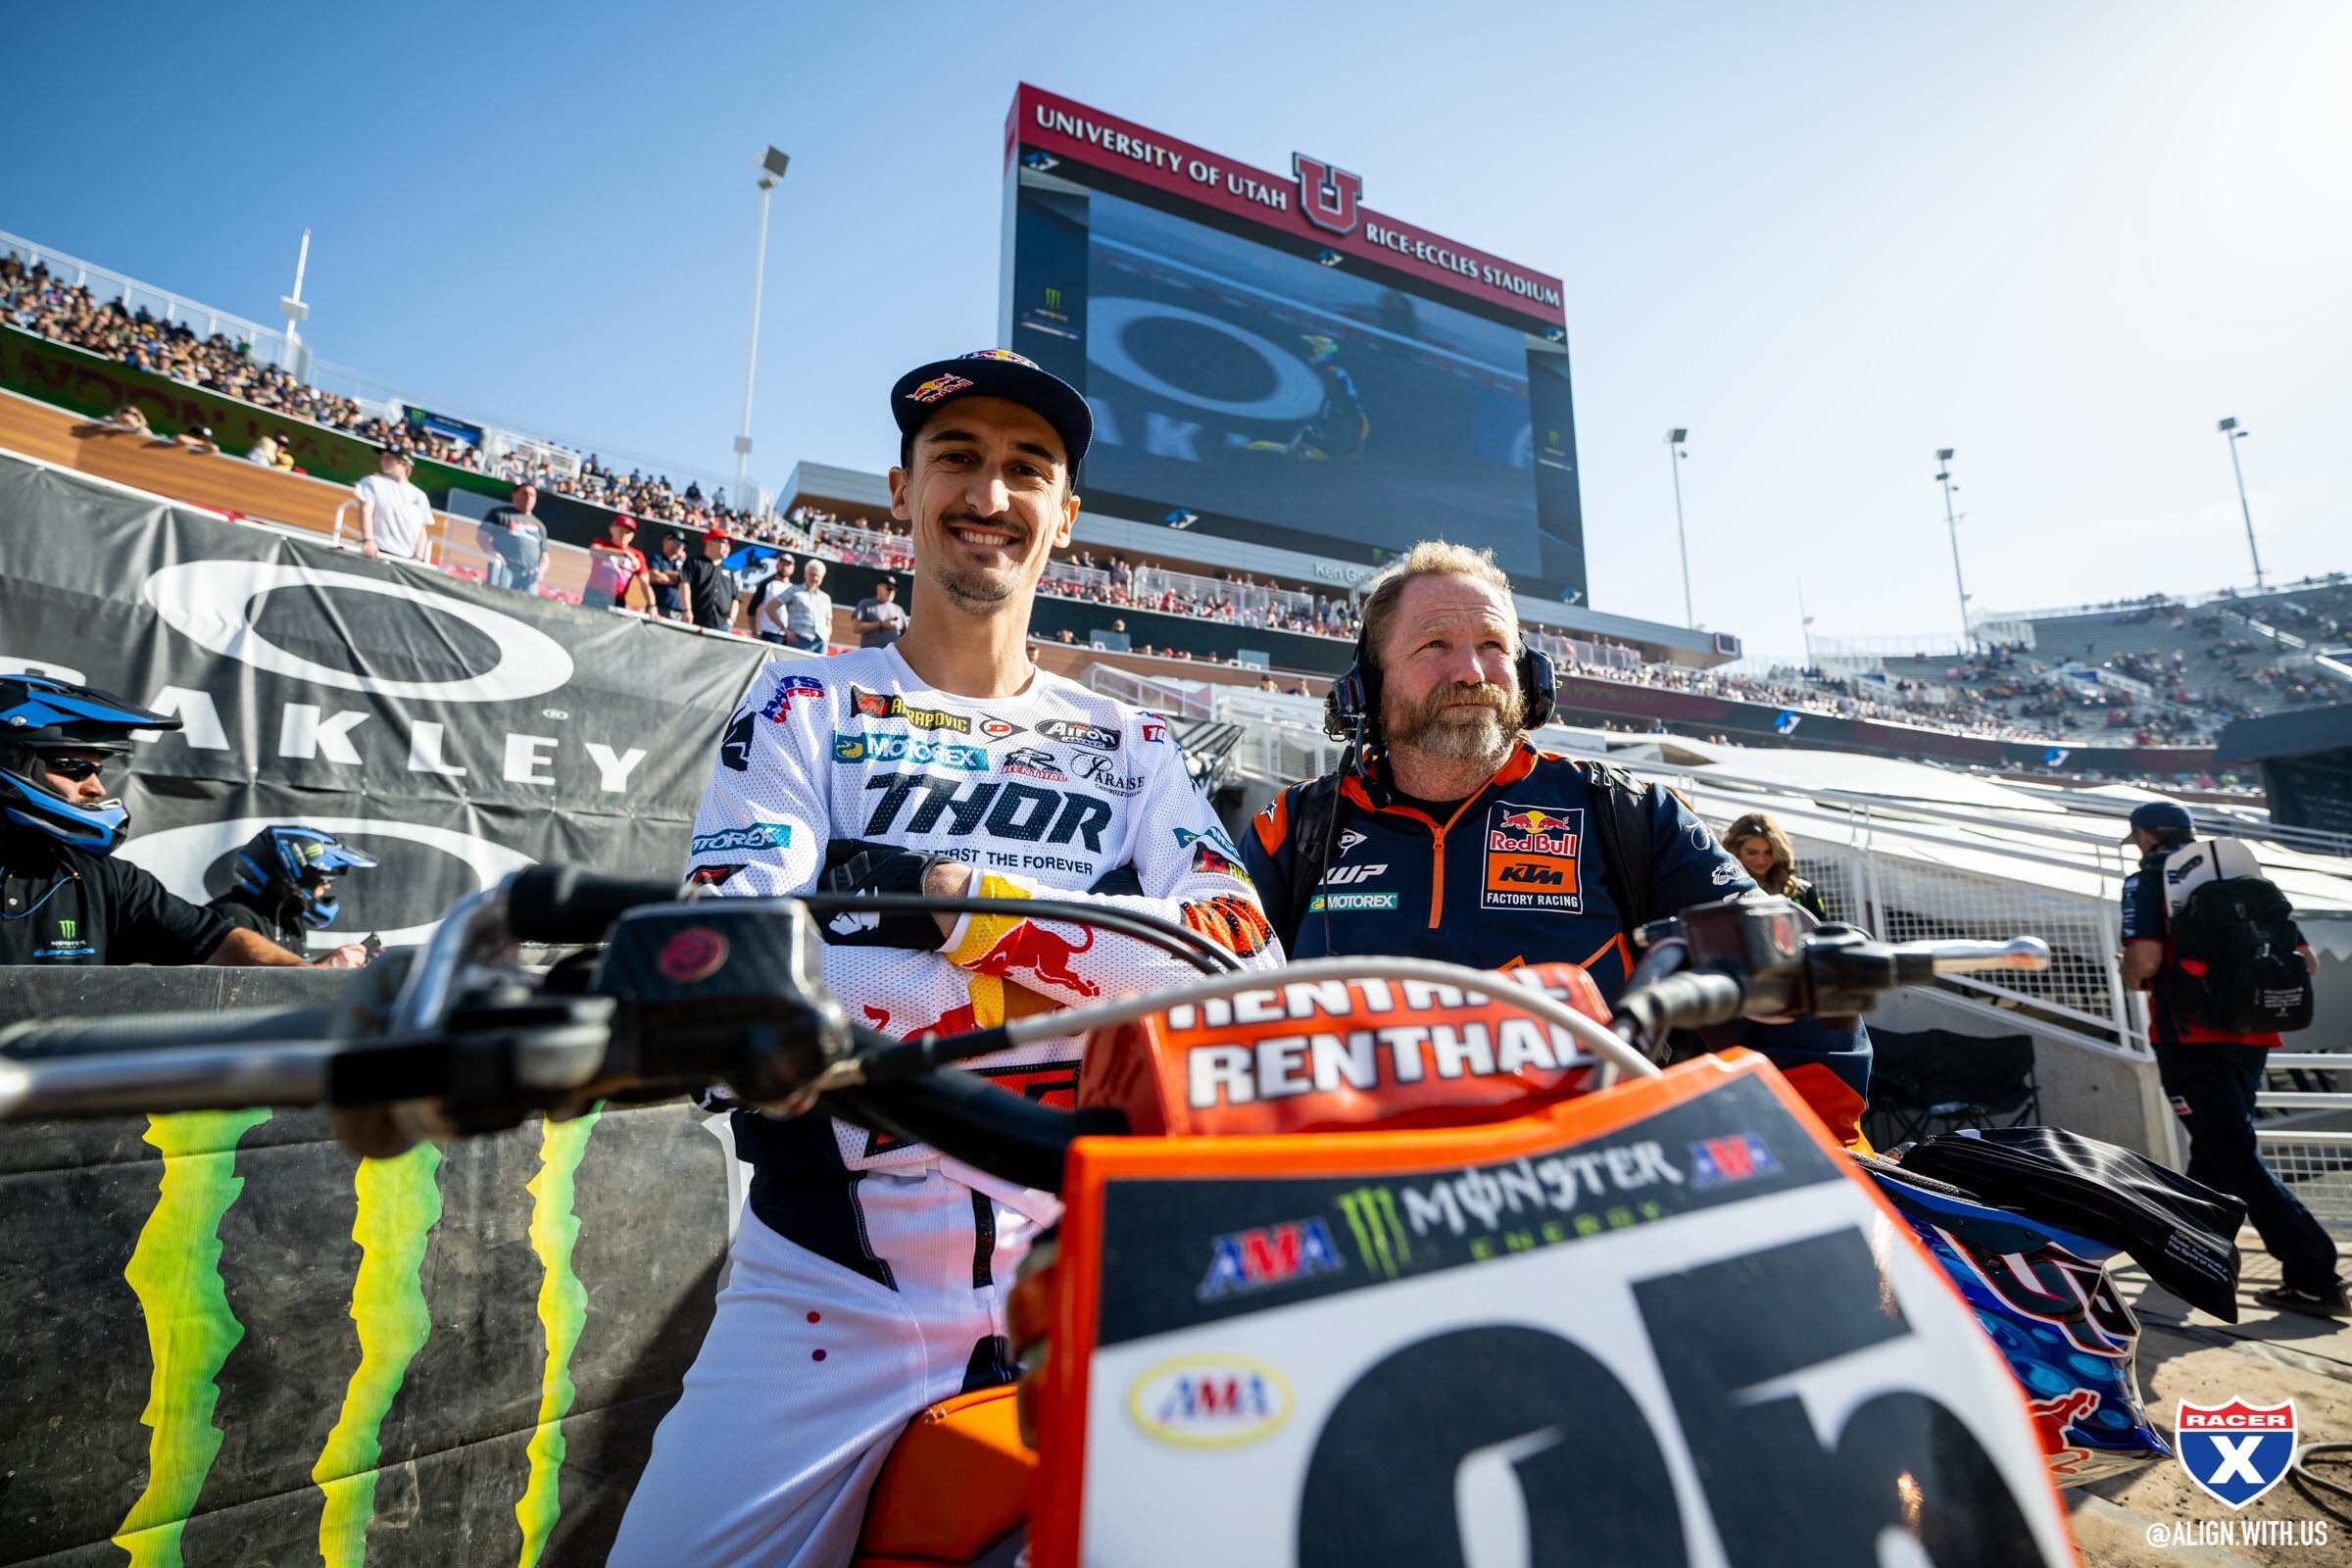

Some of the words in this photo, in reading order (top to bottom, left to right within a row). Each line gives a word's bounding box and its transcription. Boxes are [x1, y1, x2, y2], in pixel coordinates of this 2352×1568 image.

[1037, 104, 1183, 173] UNIVERSITY
[1188, 161, 1220, 186] OF
[1227, 172, 1287, 212] UTAH
[1365, 221, 1479, 278] RICE-ECCLES
[1483, 265, 1561, 308] STADIUM
[1314, 562, 1344, 579] Ken
[0, 656, 648, 792] AKLEY
[1002, 764, 1068, 782] RENTHAL
[862, 771, 1113, 855] THOR
[986, 851, 1019, 867] THE
[1023, 857, 1094, 876] FOREVER
[1490, 829, 1534, 852] Red
[1534, 833, 1578, 857] Bull
[1317, 863, 1389, 886] WP
[1497, 862, 1564, 886] KTM
[1327, 895, 1395, 909] MOTOREX
[1487, 892, 1534, 906] FACTORY
[1537, 895, 1579, 907] RACING
[1187, 1016, 1599, 1109] RENTHAL
[1688, 1132, 1784, 1192] AMA
[1197, 1215, 1347, 1303] AMA
[1155, 1371, 1269, 1425] AMA
